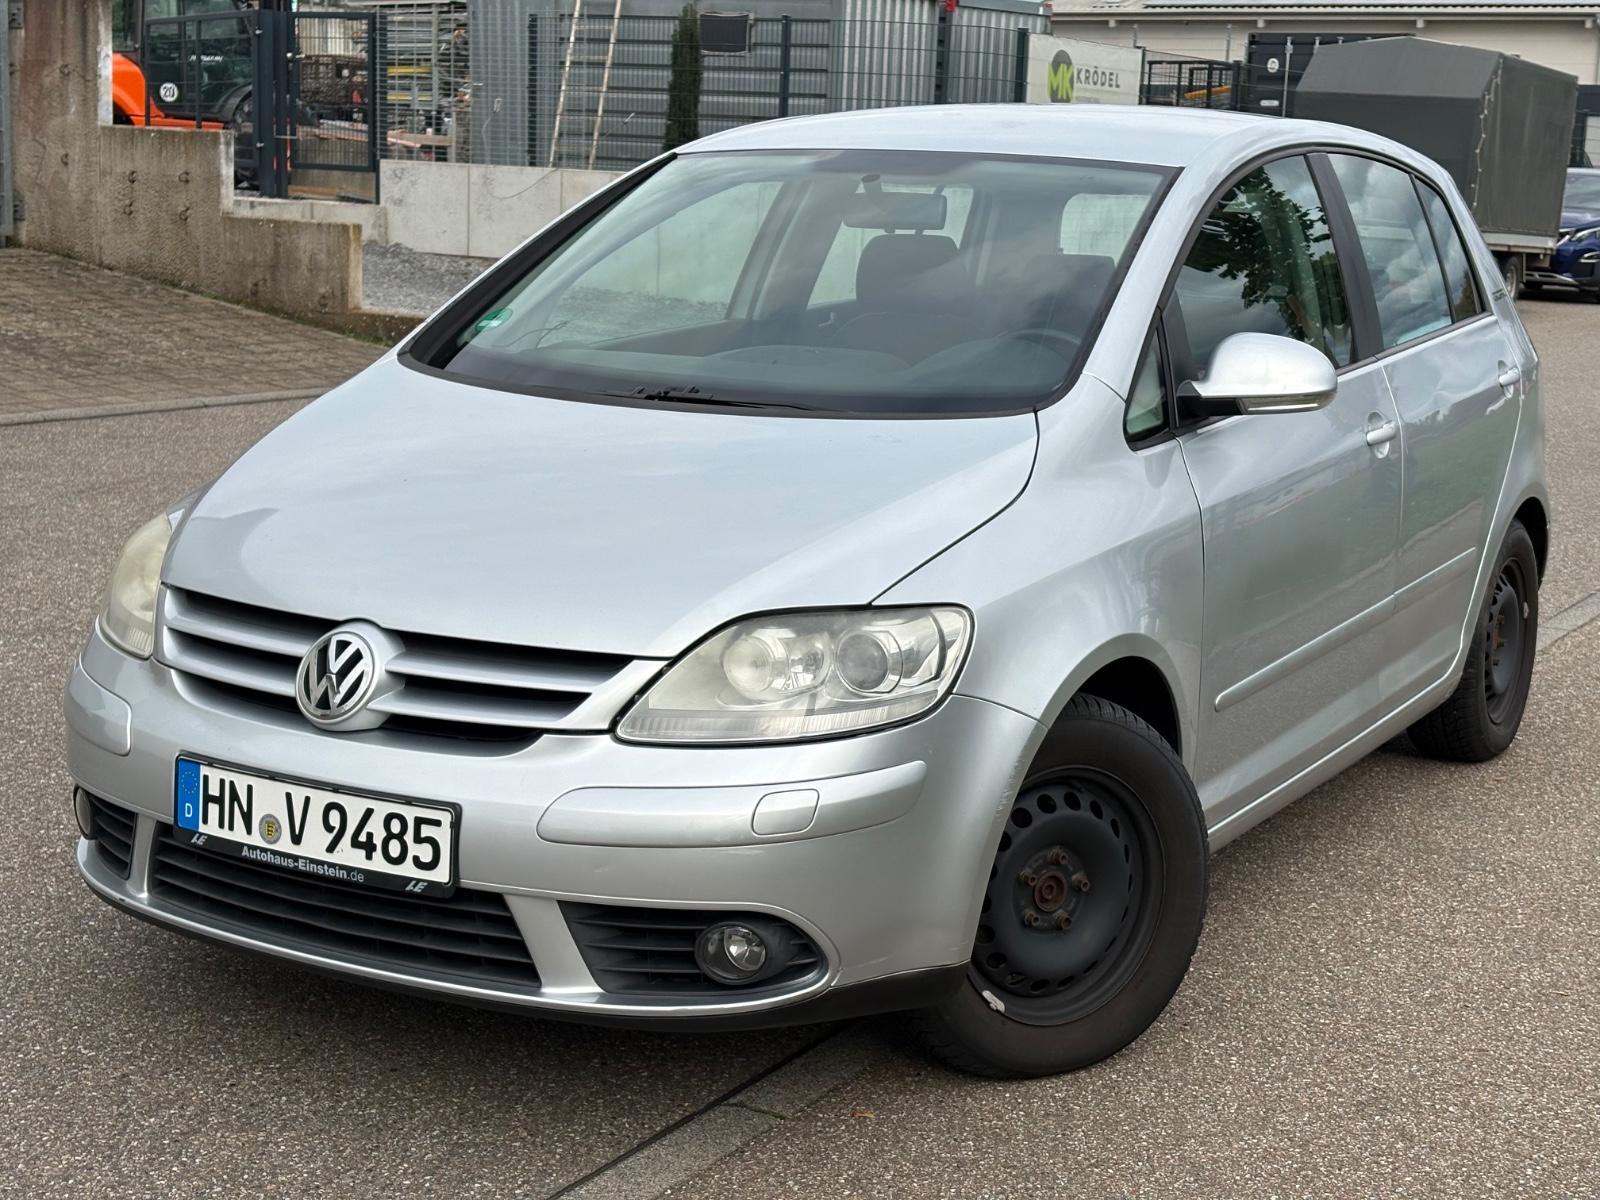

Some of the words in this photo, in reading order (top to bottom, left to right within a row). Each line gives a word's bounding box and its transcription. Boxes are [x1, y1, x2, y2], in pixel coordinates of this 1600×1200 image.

[1047, 63, 1075, 100] MK
[301, 632, 374, 720] VW
[185, 802, 193, 818] D
[202, 774, 253, 836] HN
[285, 791, 311, 845] V
[321, 801, 442, 871] 9485
[241, 845, 365, 883] Autohaus-Einstein.de
